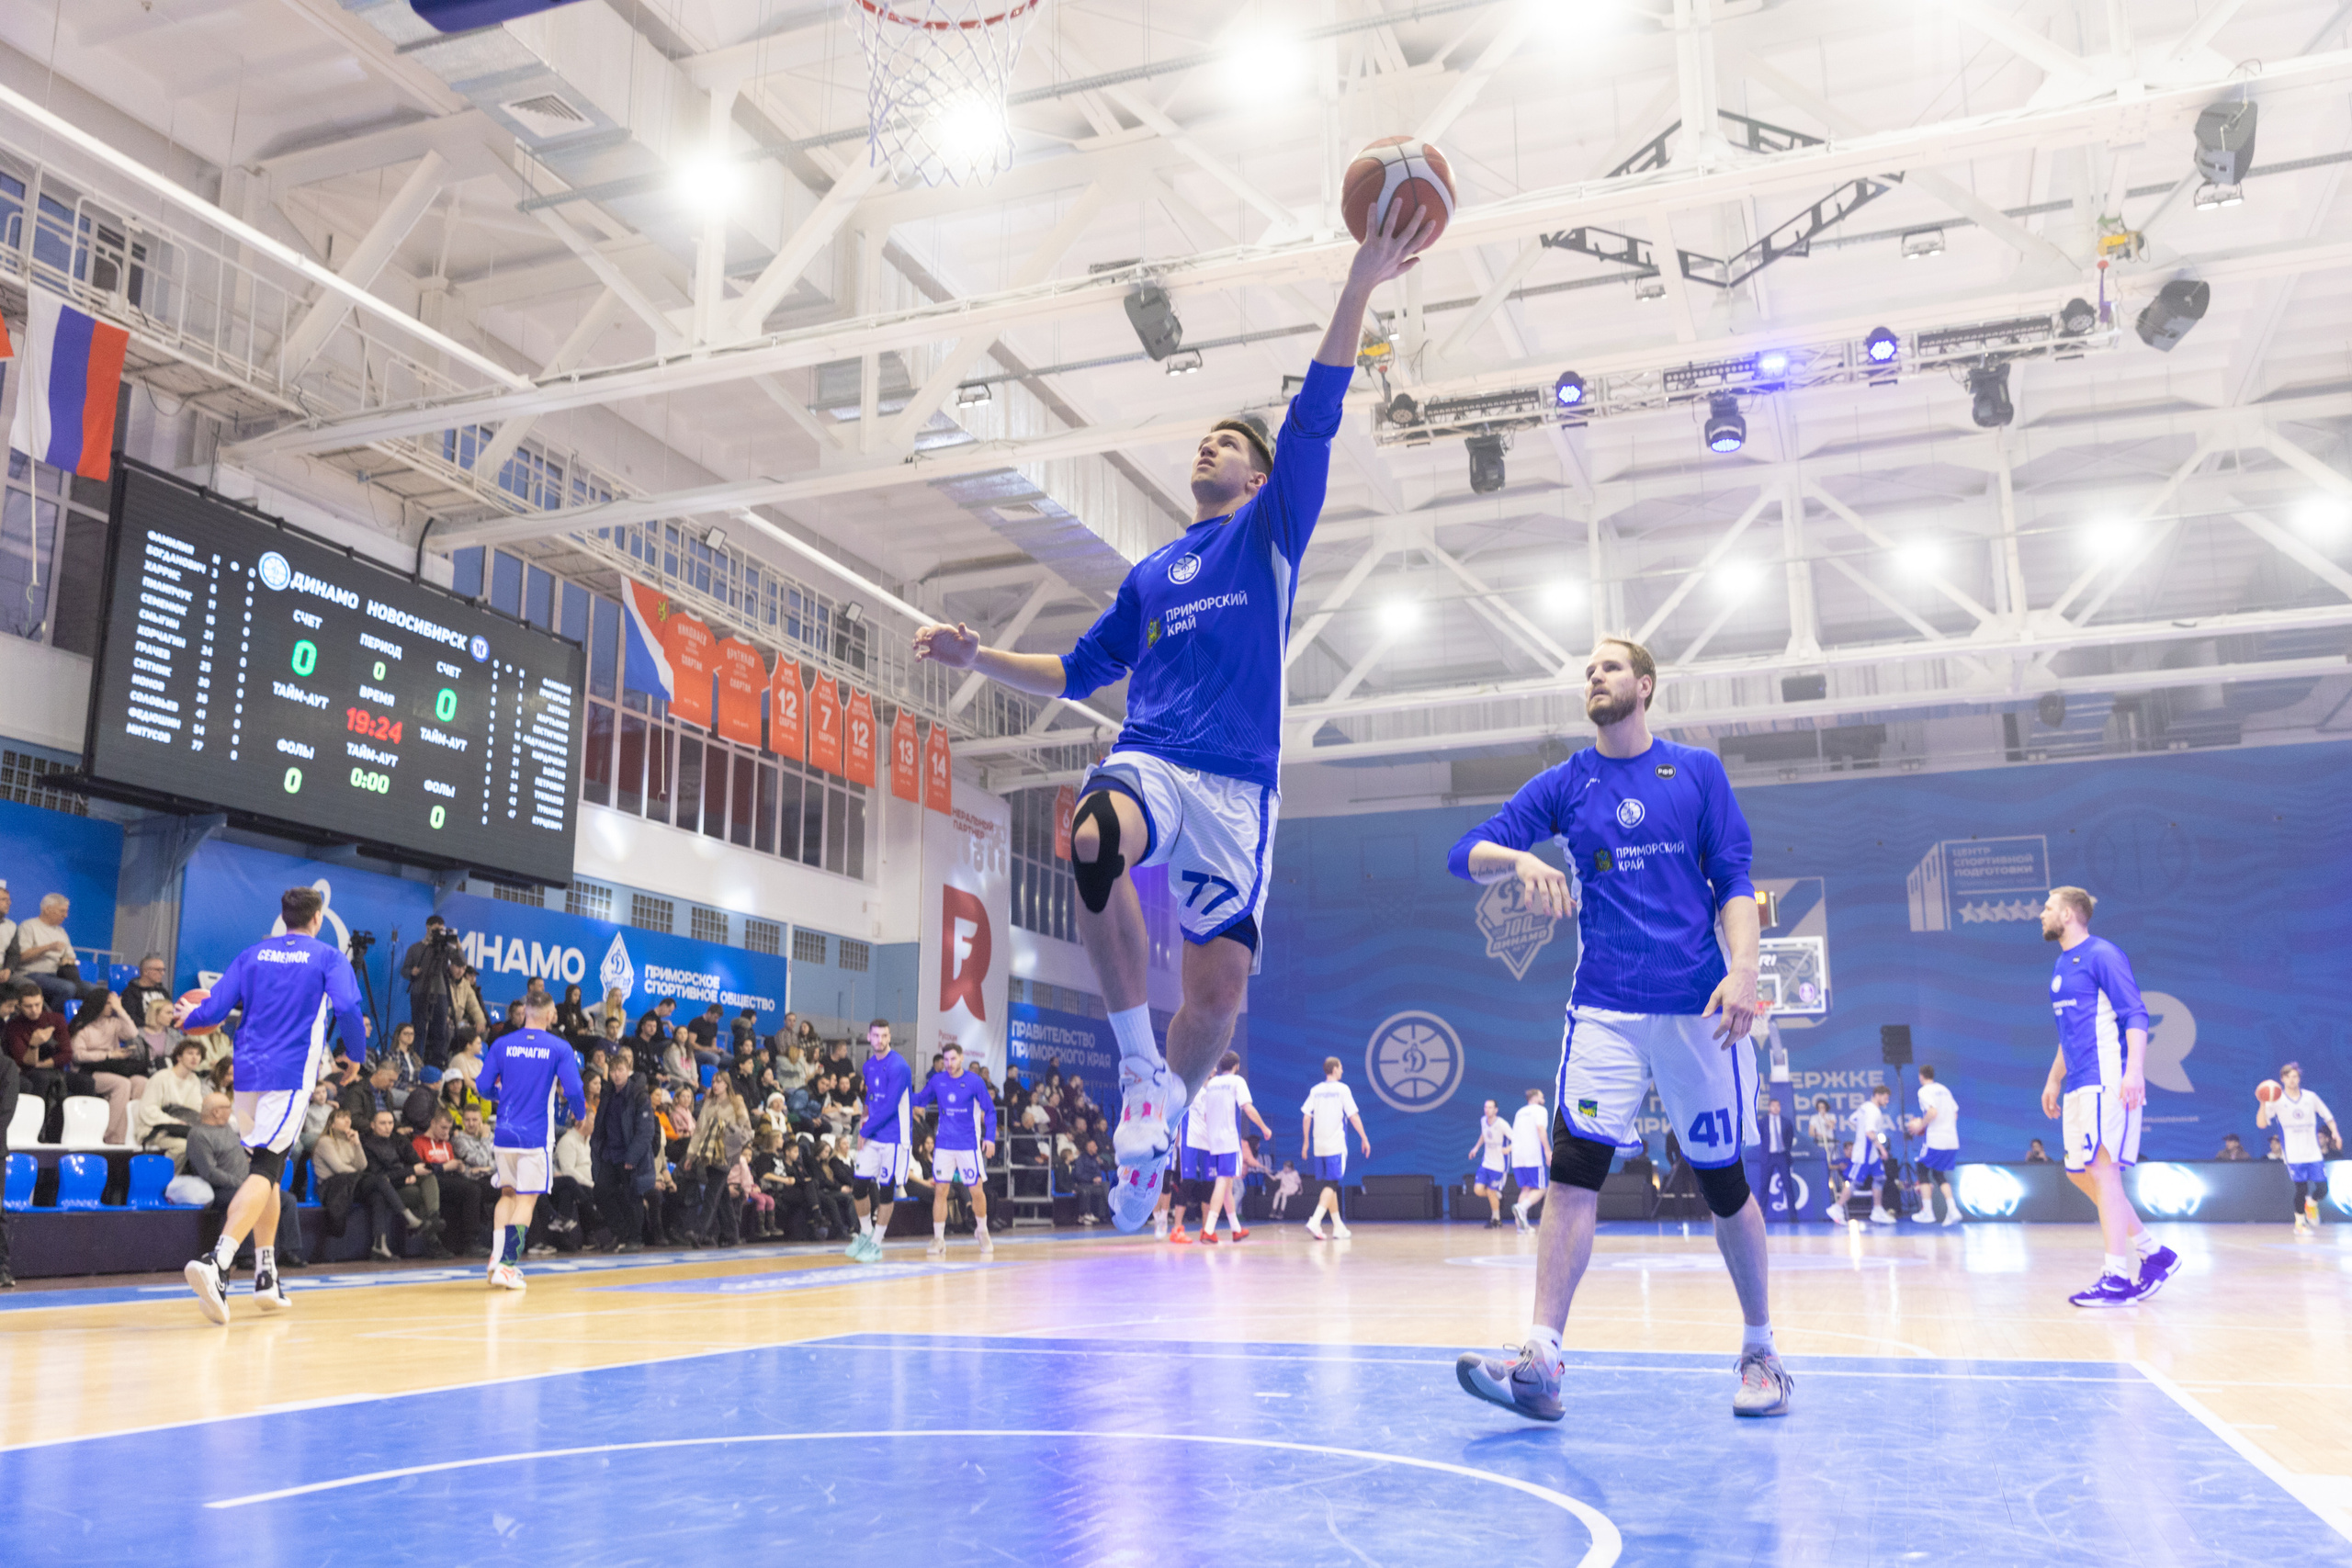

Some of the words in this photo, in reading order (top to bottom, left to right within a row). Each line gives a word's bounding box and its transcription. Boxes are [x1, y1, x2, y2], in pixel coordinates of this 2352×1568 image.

[147, 530, 195, 556] ФАМИЛИЯ
[143, 559, 181, 581] ХАРРИС
[145, 544, 207, 574] БОГДАНОВИЧ
[141, 592, 187, 616] СЕМЕНЮК
[290, 571, 359, 609] ДИНАМО
[367, 600, 468, 651] НОВОСИБИРСК
[1166, 590, 1248, 622] ПРИМОРСКИЙ
[293, 609, 322, 629] СЧЕТ
[1167, 615, 1196, 637] КРАЙ
[137, 625, 187, 649] КОРЧАГИН
[360, 633, 402, 660] ПЕРИОД
[291, 639, 317, 677] 0
[436, 660, 462, 679] СЧЕТ
[373, 661, 386, 681] 0
[130, 690, 179, 712] СОЛОВЬЕВ
[273, 682, 329, 710] ТАЙМ-АУТ
[359, 684, 395, 707] ВРЕМЯ
[435, 688, 458, 722] 0
[778, 687, 797, 719] 12
[346, 707, 403, 744] 19:24
[821, 705, 831, 731] 7
[191, 739, 204, 751] 77
[420, 727, 468, 752] ТАЙМ-АУТ
[852, 720, 869, 749] 12
[277, 739, 315, 760] ФОЛЫ
[346, 742, 399, 768] ТАЙМ-АУТ
[899, 739, 913, 765] 13
[932, 752, 946, 779] 14
[284, 767, 302, 794] 0
[350, 767, 390, 795] 0:00
[424, 779, 456, 798] ФОЛЫ
[430, 806, 446, 829] 0
[953, 819, 985, 839] ПАРТНЕР
[1616, 840, 1684, 859] ПРИМОРСКИЙ
[1953, 854, 2033, 867] СПОРТИВНОЙ
[1618, 855, 1645, 872] КРАЙ
[1954, 865, 2033, 876] ПОДГОТОВКИ
[1182, 870, 1238, 916] 77
[257, 949, 311, 964] СЕМЕНЮК
[461, 931, 585, 984] ИНАМО
[645, 964, 720, 989] ПРИМОРСКОЕ
[644, 979, 719, 1003] СПОРТИВНОЕ
[720, 989, 775, 1012] ОБЩЕСТВО
[1012, 1020, 1095, 1048] ПРАВИТЕЛЬСТВО
[506, 1044, 550, 1060] КОРЧАГИН
[1011, 1043, 1085, 1066] ПРИМОРСКОГО
[1087, 1051, 1111, 1068] КРАЯ
[1689, 1108, 1733, 1147] 41
[881, 1168, 888, 1178] 3
